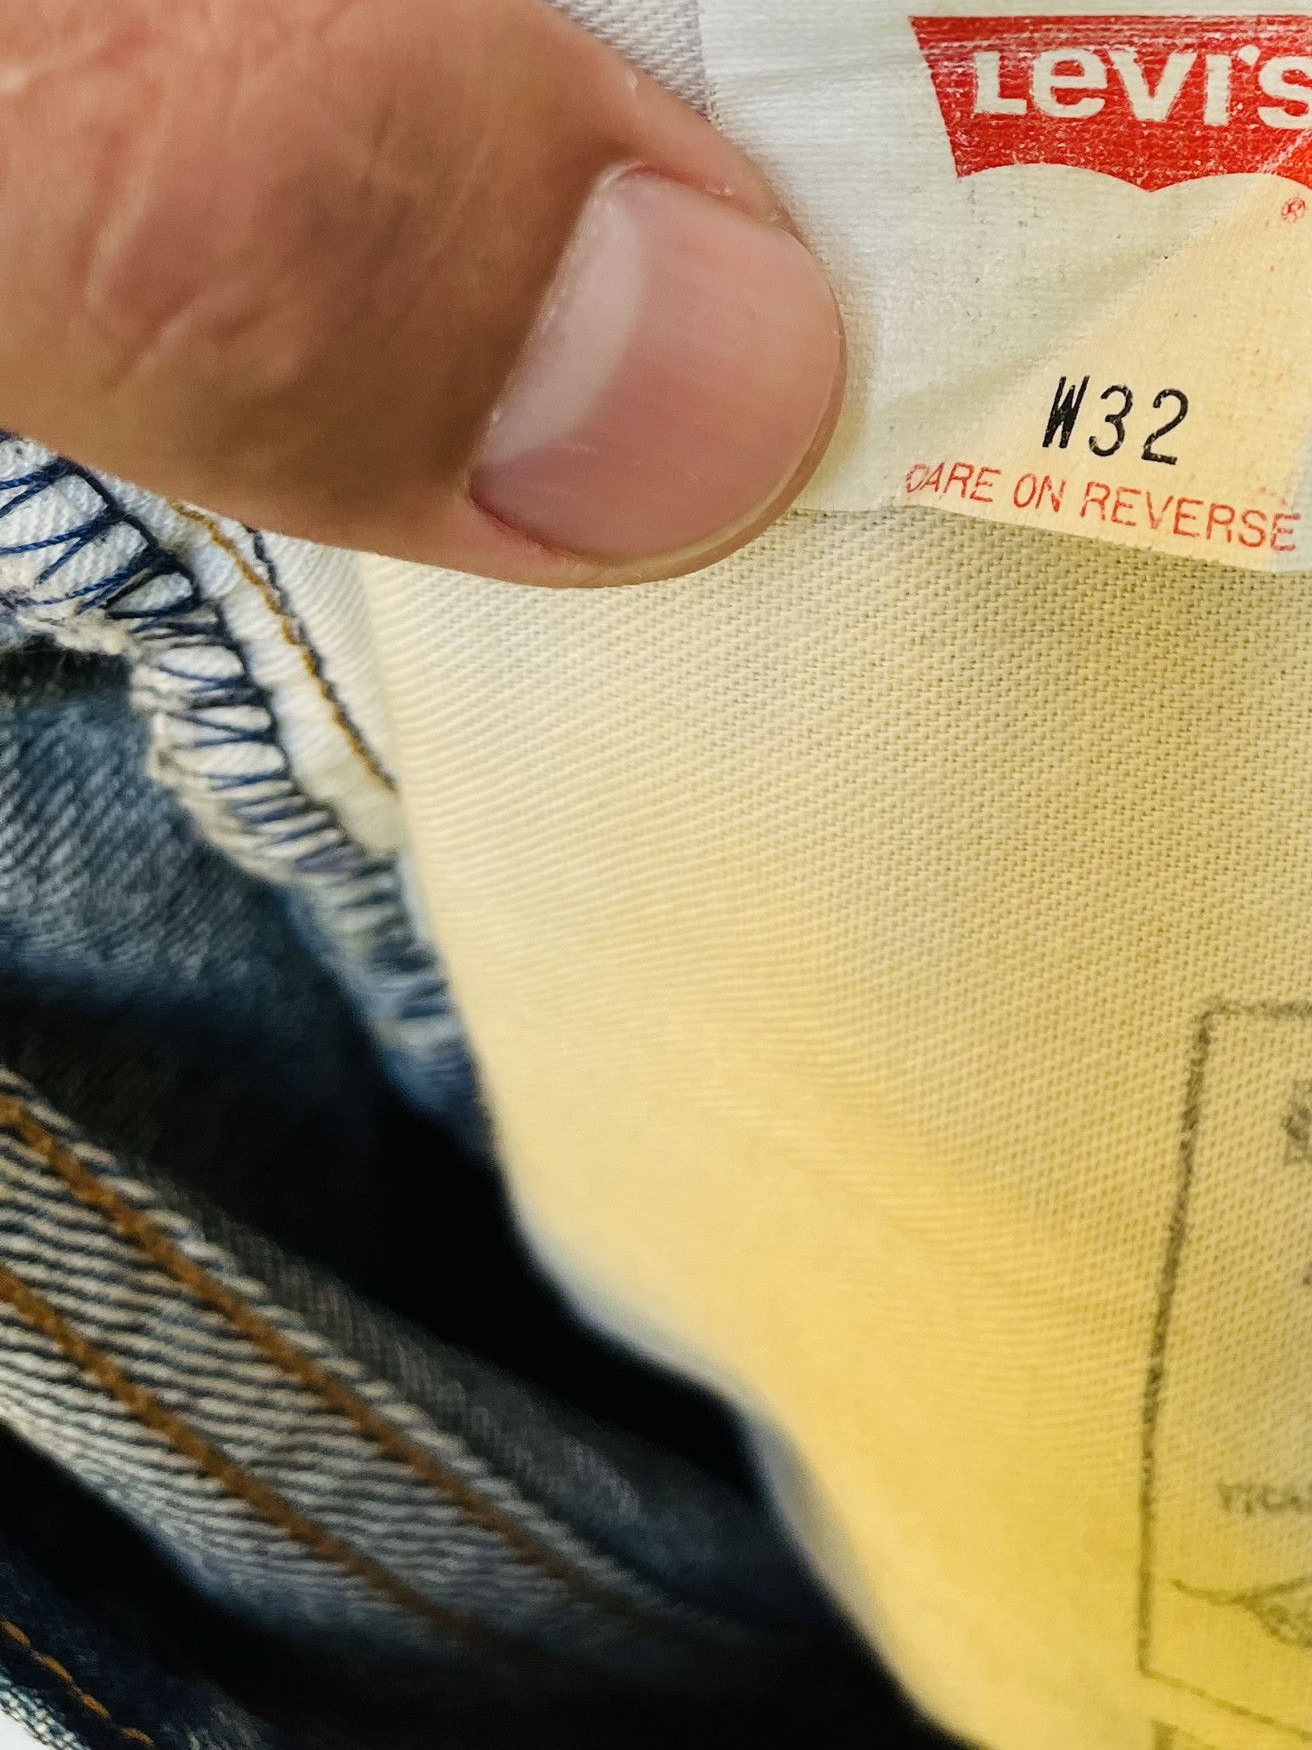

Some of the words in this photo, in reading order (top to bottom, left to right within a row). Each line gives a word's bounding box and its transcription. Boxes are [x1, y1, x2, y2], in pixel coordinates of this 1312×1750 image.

[1042, 374, 1190, 466] W32
[905, 461, 1003, 505] CARE
[1013, 472, 1067, 514] ON
[1080, 481, 1302, 552] REVERSE
